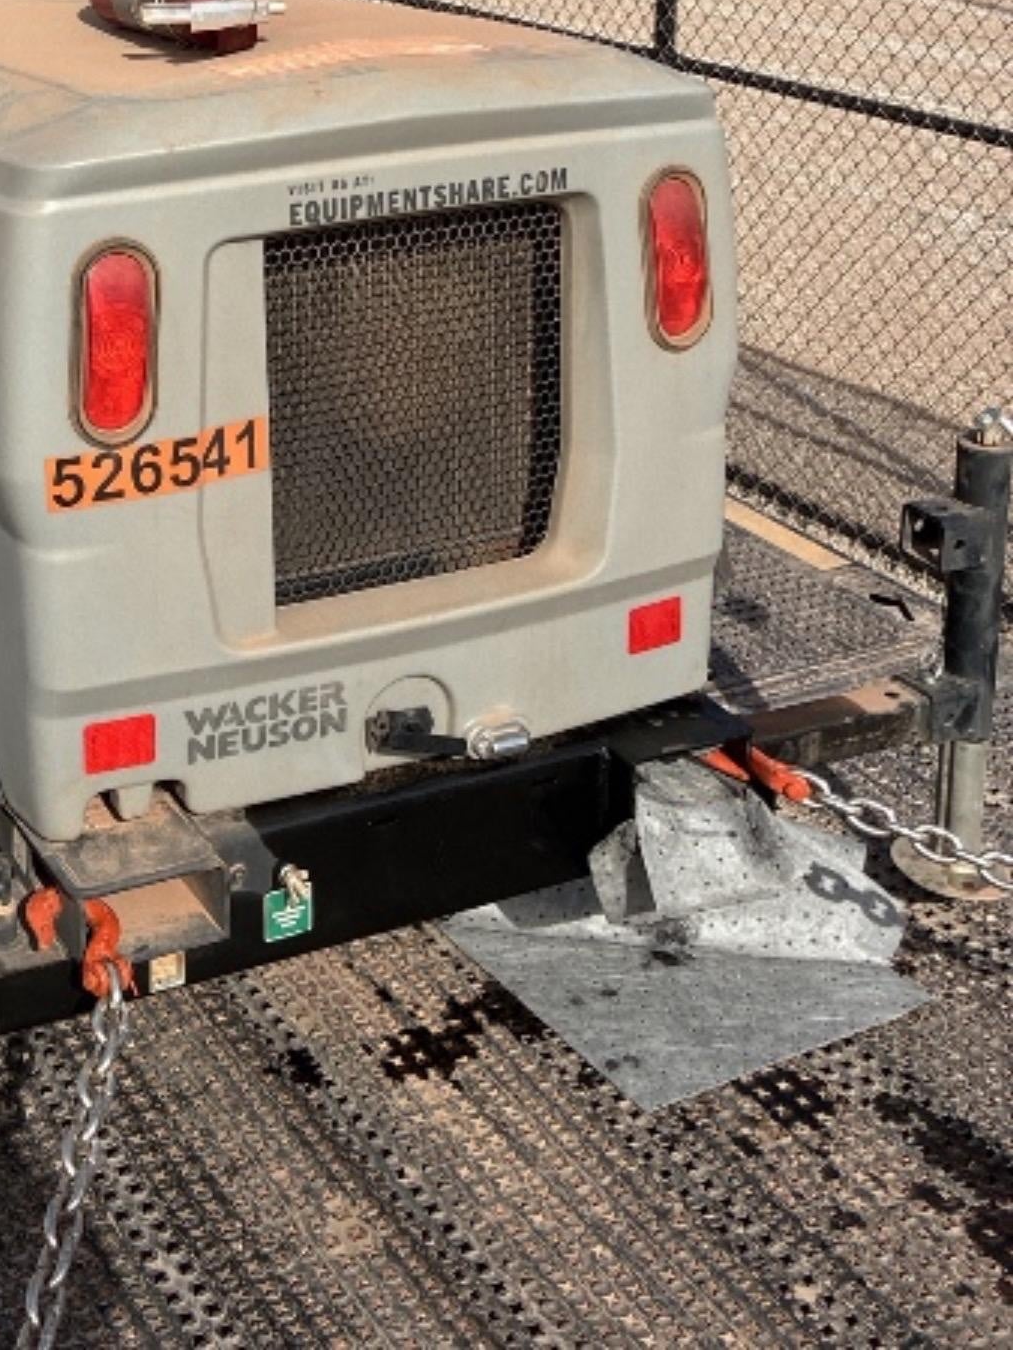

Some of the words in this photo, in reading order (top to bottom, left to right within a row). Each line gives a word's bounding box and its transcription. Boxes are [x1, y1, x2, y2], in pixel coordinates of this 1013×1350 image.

[289, 167, 568, 226] EQUIPMENTSHARE.COM
[51, 419, 256, 508] 526541
[184, 680, 348, 736] WACKER
[187, 707, 348, 766] NEUSON
